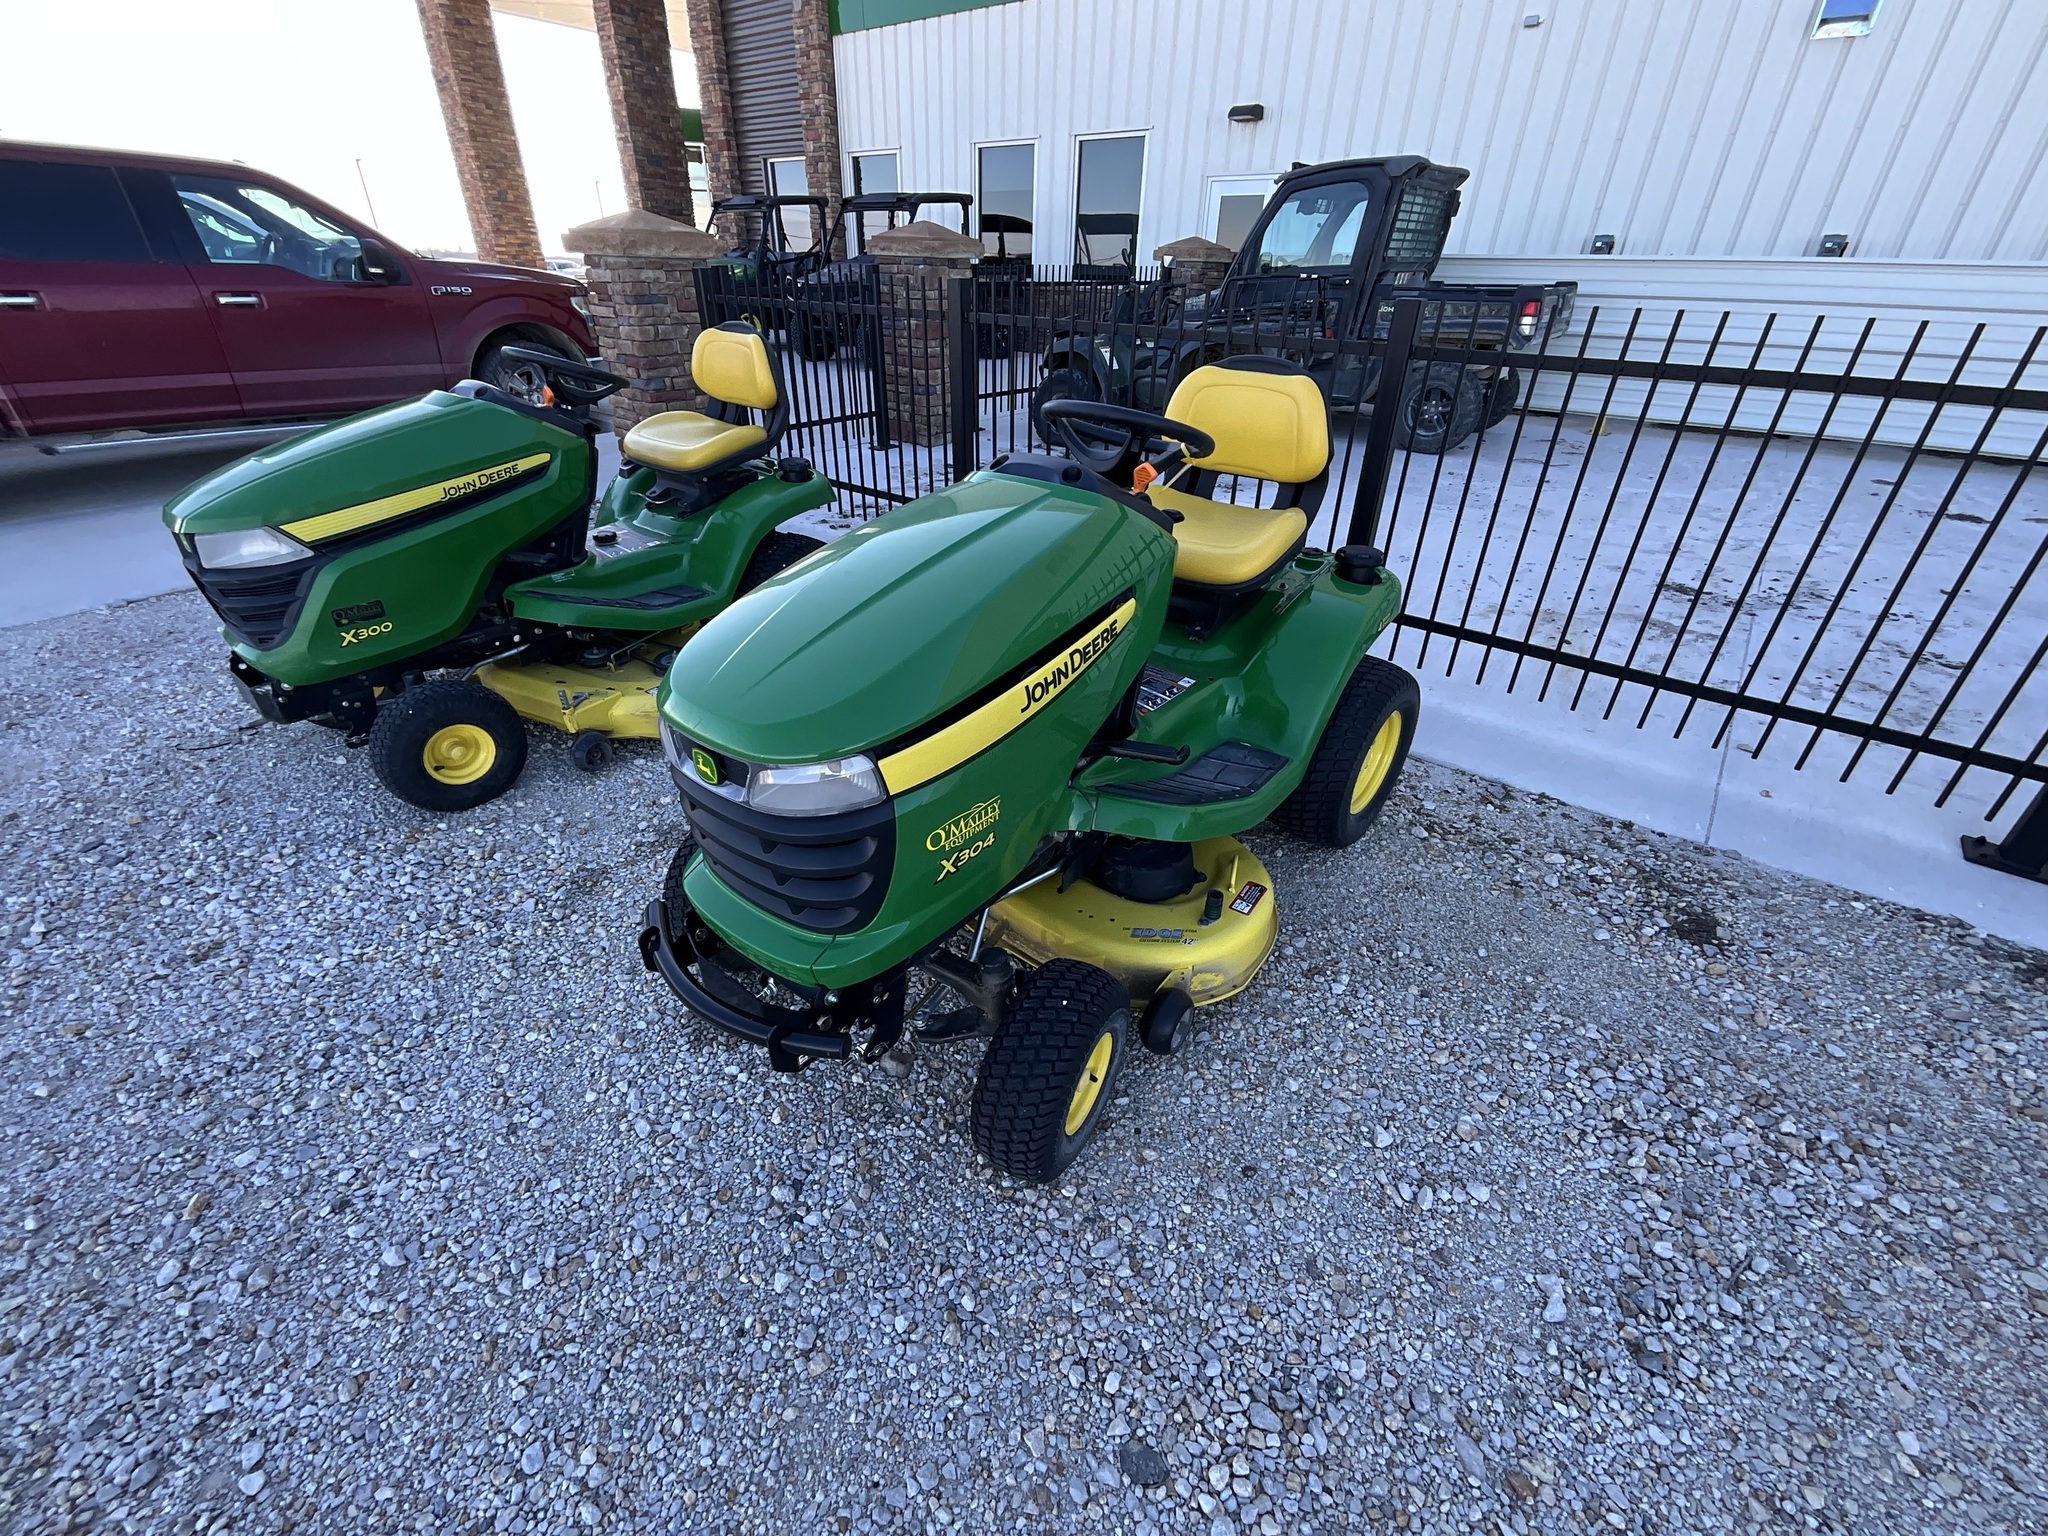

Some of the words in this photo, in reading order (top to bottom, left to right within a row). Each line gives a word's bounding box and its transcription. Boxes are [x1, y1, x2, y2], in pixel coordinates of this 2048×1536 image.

[1378, 305, 1395, 313] JOH
[440, 479, 477, 501] JOHN
[478, 463, 520, 487] DEERE
[339, 621, 394, 647] X300
[1020, 661, 1070, 714] JOHN
[1068, 618, 1118, 675] DEERE
[926, 799, 1001, 852] O'MALLEY
[945, 812, 1001, 852] EQUIPMENT
[936, 831, 995, 882] X304
[1130, 926, 1184, 939] EDGE
